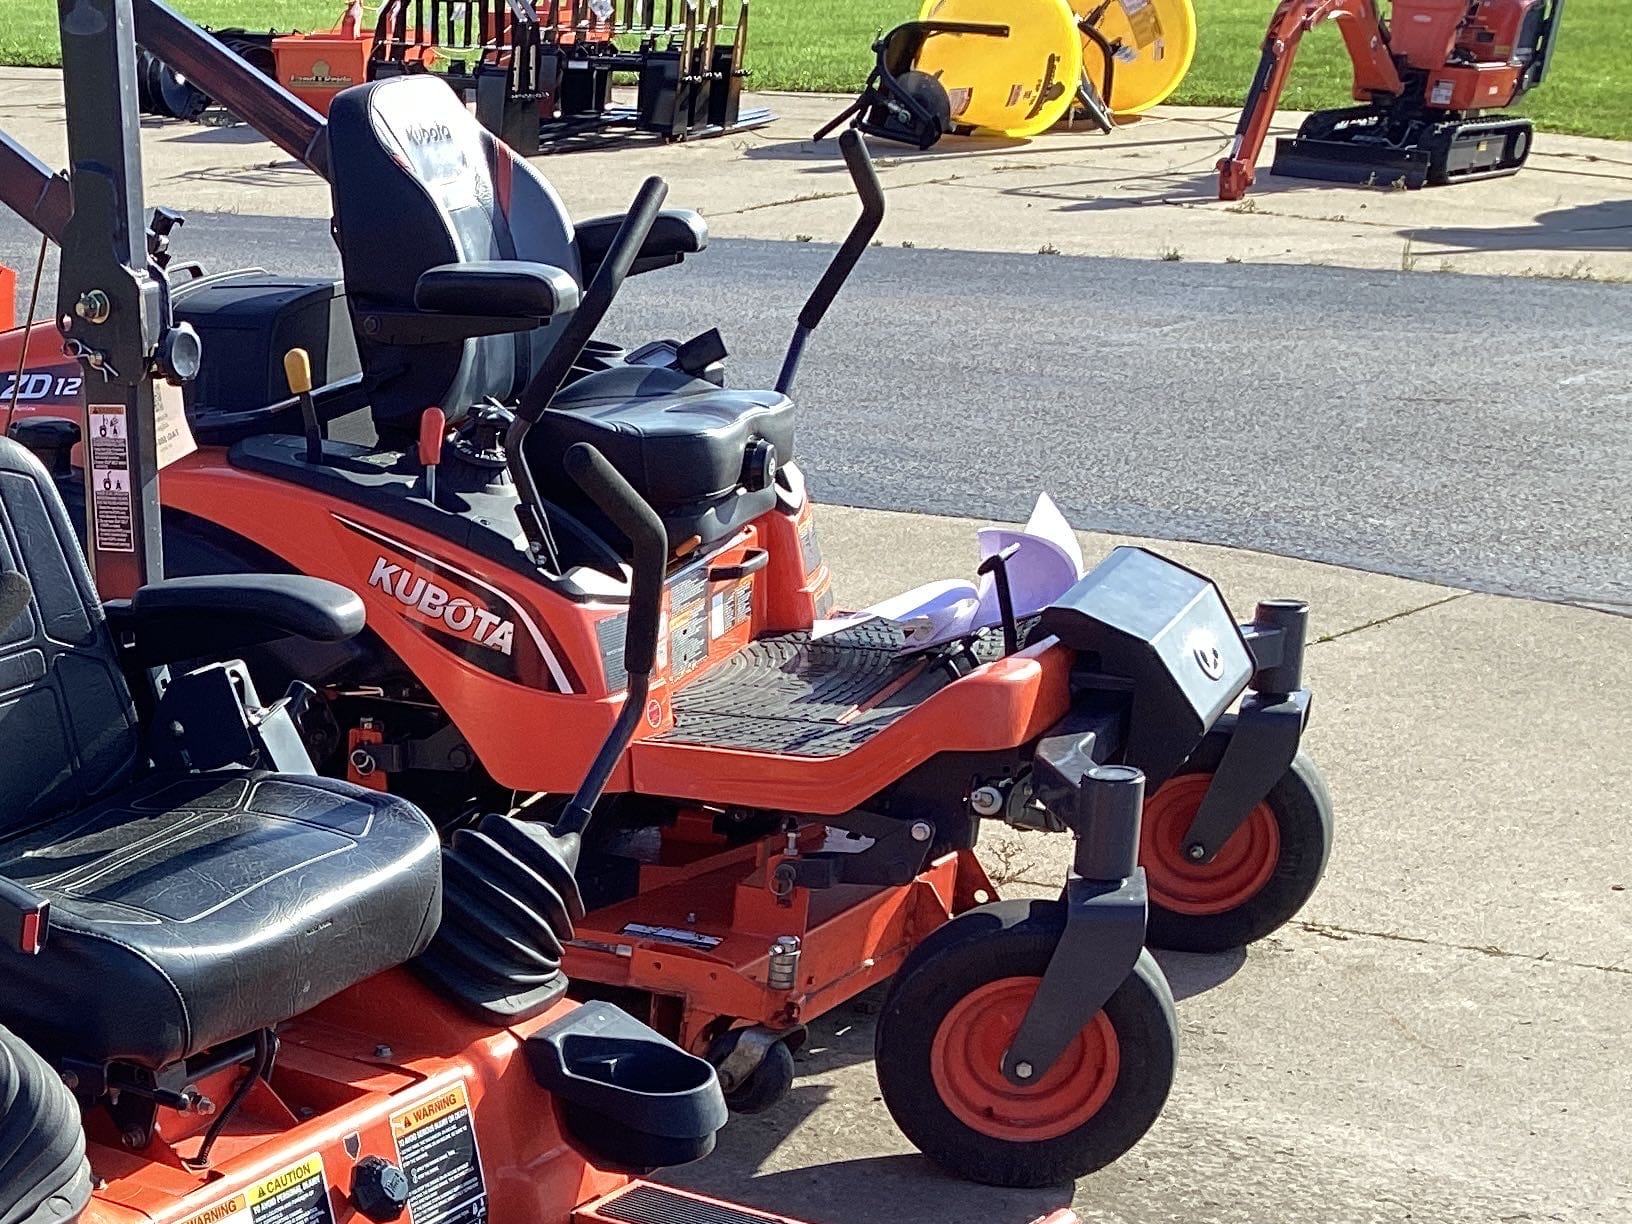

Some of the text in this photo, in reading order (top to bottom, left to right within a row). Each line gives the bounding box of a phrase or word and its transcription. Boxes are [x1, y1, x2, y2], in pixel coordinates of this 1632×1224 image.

[406, 120, 451, 146] Kubota
[368, 556, 515, 656] KUBOTA
[414, 1094, 457, 1122] WARNING
[266, 1164, 311, 1194] CAUTION
